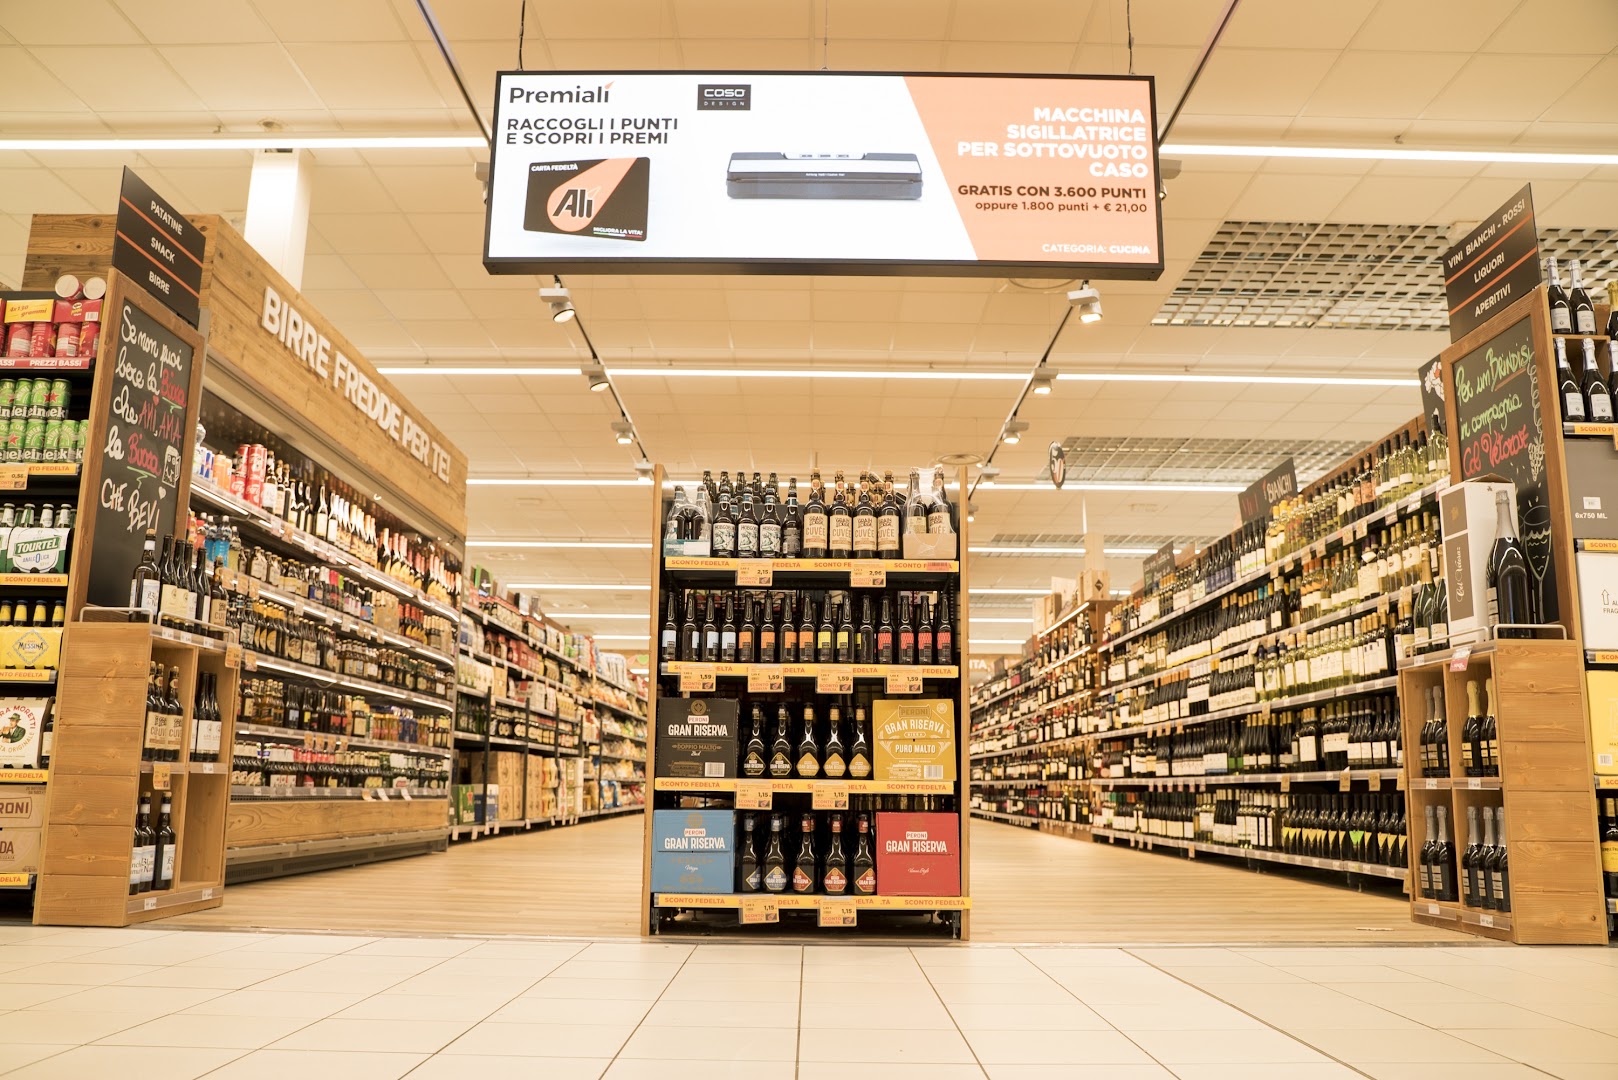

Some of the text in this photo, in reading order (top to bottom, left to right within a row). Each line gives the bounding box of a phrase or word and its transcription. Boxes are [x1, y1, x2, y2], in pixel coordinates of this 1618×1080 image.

[507, 117, 679, 131] RACCOGLI I PUNTI
[1033, 107, 1146, 123] MACCHINA
[506, 132, 668, 145] E SCOPRI I PREMI
[1006, 124, 1147, 142] SIGILLATRICE
[957, 141, 1148, 160] PER SOTTOVUOTO
[1089, 162, 1149, 178] CASO
[957, 185, 1146, 198] GRATIS CON 3.600 PUNTI
[975, 202, 1018, 213] oppure
[1021, 201, 1055, 211] 1.800
[1058, 202, 1089, 214] punti
[1103, 203, 1112, 212] €
[1115, 203, 1147, 214] 21,00
[151, 200, 183, 236] PATATINE
[1448, 250, 1464, 269] VINI
[1465, 221, 1496, 254] BIANCHI
[1502, 198, 1525, 225] ROSSI
[150, 237, 176, 264] SNACK
[1042, 243, 1150, 254] CATEGORIA: CUCINA
[1473, 251, 1505, 284] LIQUORI
[148, 270, 171, 295] BIRRE
[1474, 282, 1511, 318] APERITIVI
[121, 305, 138, 345] Se
[137, 331, 159, 358] non
[160, 344, 183, 378] puoi
[115, 345, 144, 389] bere
[147, 362, 160, 396] la
[261, 285, 332, 379] BIRRE
[332, 350, 402, 442] FREDDE
[401, 415, 430, 467] PER
[1456, 365, 1474, 406] Per
[113, 385, 138, 425] che
[158, 411, 181, 448] AMA
[1460, 393, 1523, 441] in compagnia
[104, 425, 125, 460] la
[1463, 440, 1482, 477] Col
[101, 478, 128, 512] CHE
[1266, 473, 1293, 504] BIANCHI
[805, 527, 826, 537] CUVÉE
[854, 527, 875, 538] CUVÉE
[879, 527, 895, 538] UVÉE
[17, 538, 58, 554] TOURTEL
[18, 641, 44, 650] MESSINA
[13, 704, 36, 729] MORETTI
[900, 707, 928, 716] PERONI
[668, 724, 728, 736] GRAN RISERVA
[884, 719, 945, 735] GRAN RISERVA
[7, 732, 35, 753] ORIGINALE
[895, 744, 936, 753] PURO MALTO
[664, 837, 726, 849] GRAN RISERVA
[886, 840, 948, 853] GRAN RISERVA
